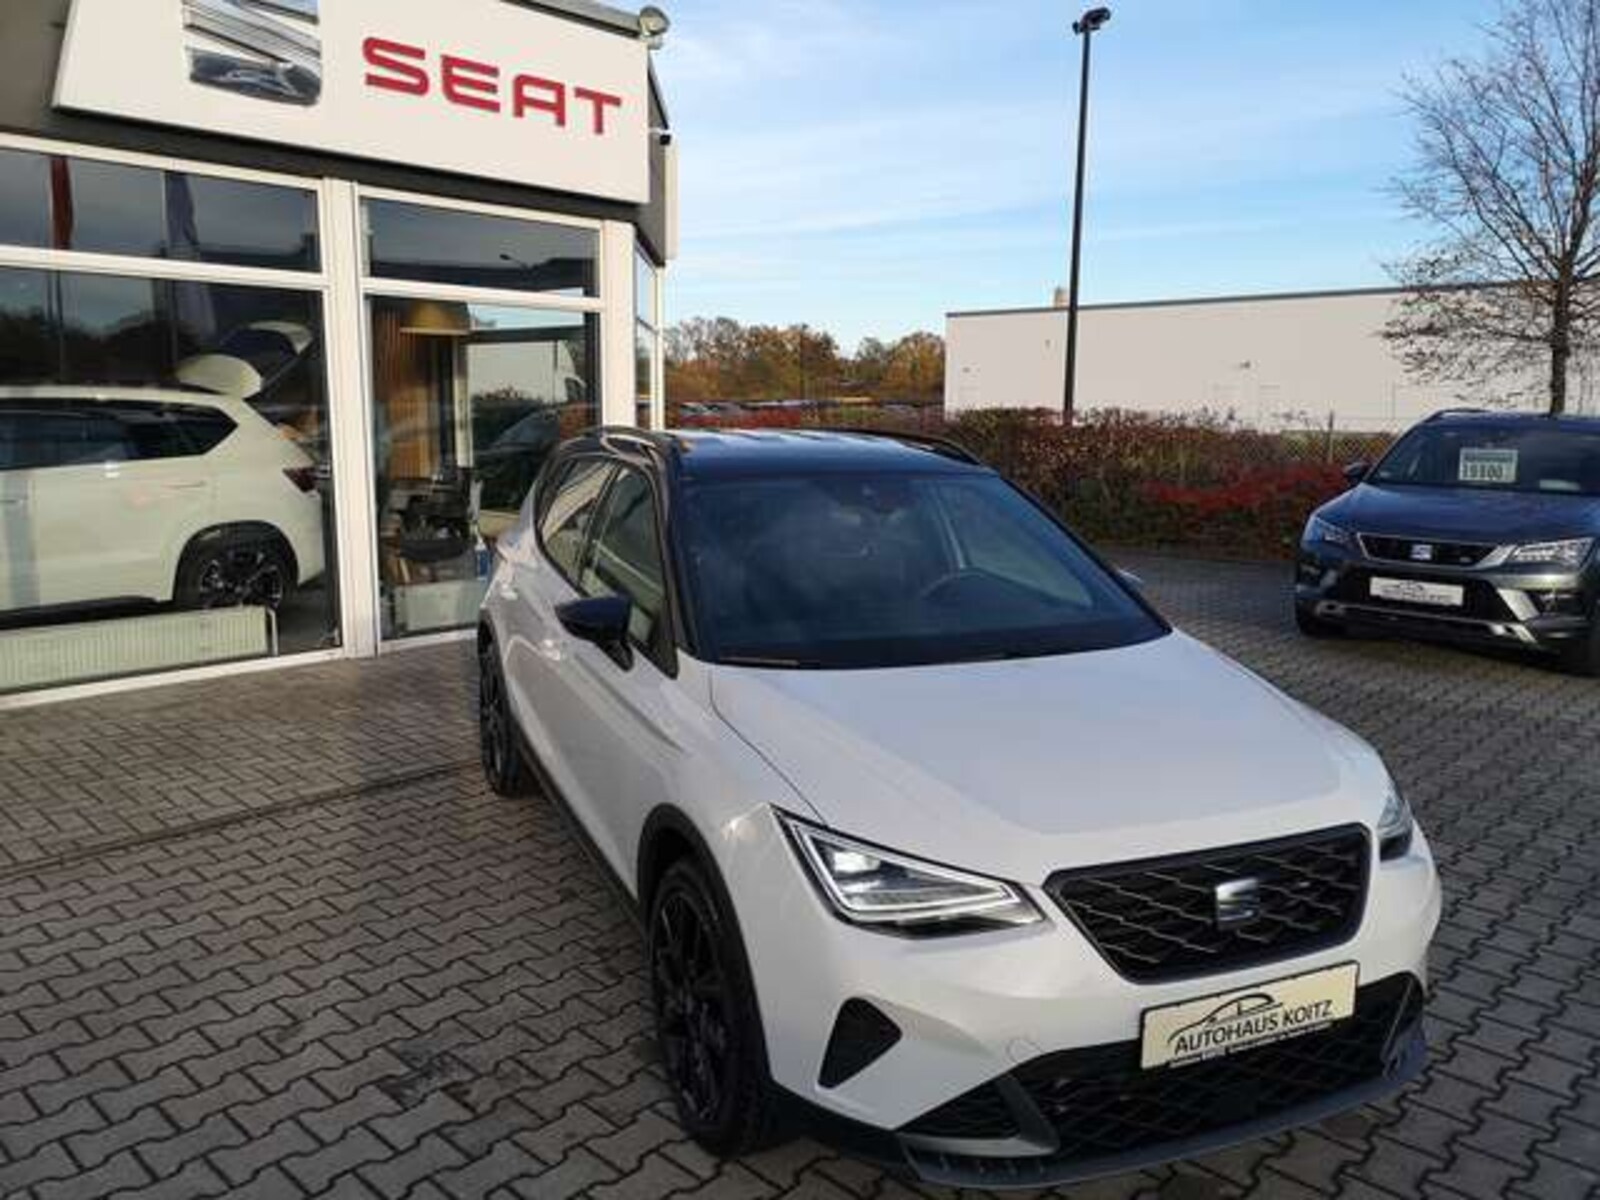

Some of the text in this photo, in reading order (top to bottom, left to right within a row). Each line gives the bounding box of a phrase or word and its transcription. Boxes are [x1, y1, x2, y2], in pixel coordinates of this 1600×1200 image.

[362, 36, 622, 135] SEAT
[1174, 1014, 1279, 1056] AUTOHAUS
[1282, 1000, 1334, 1026] KOITZ
